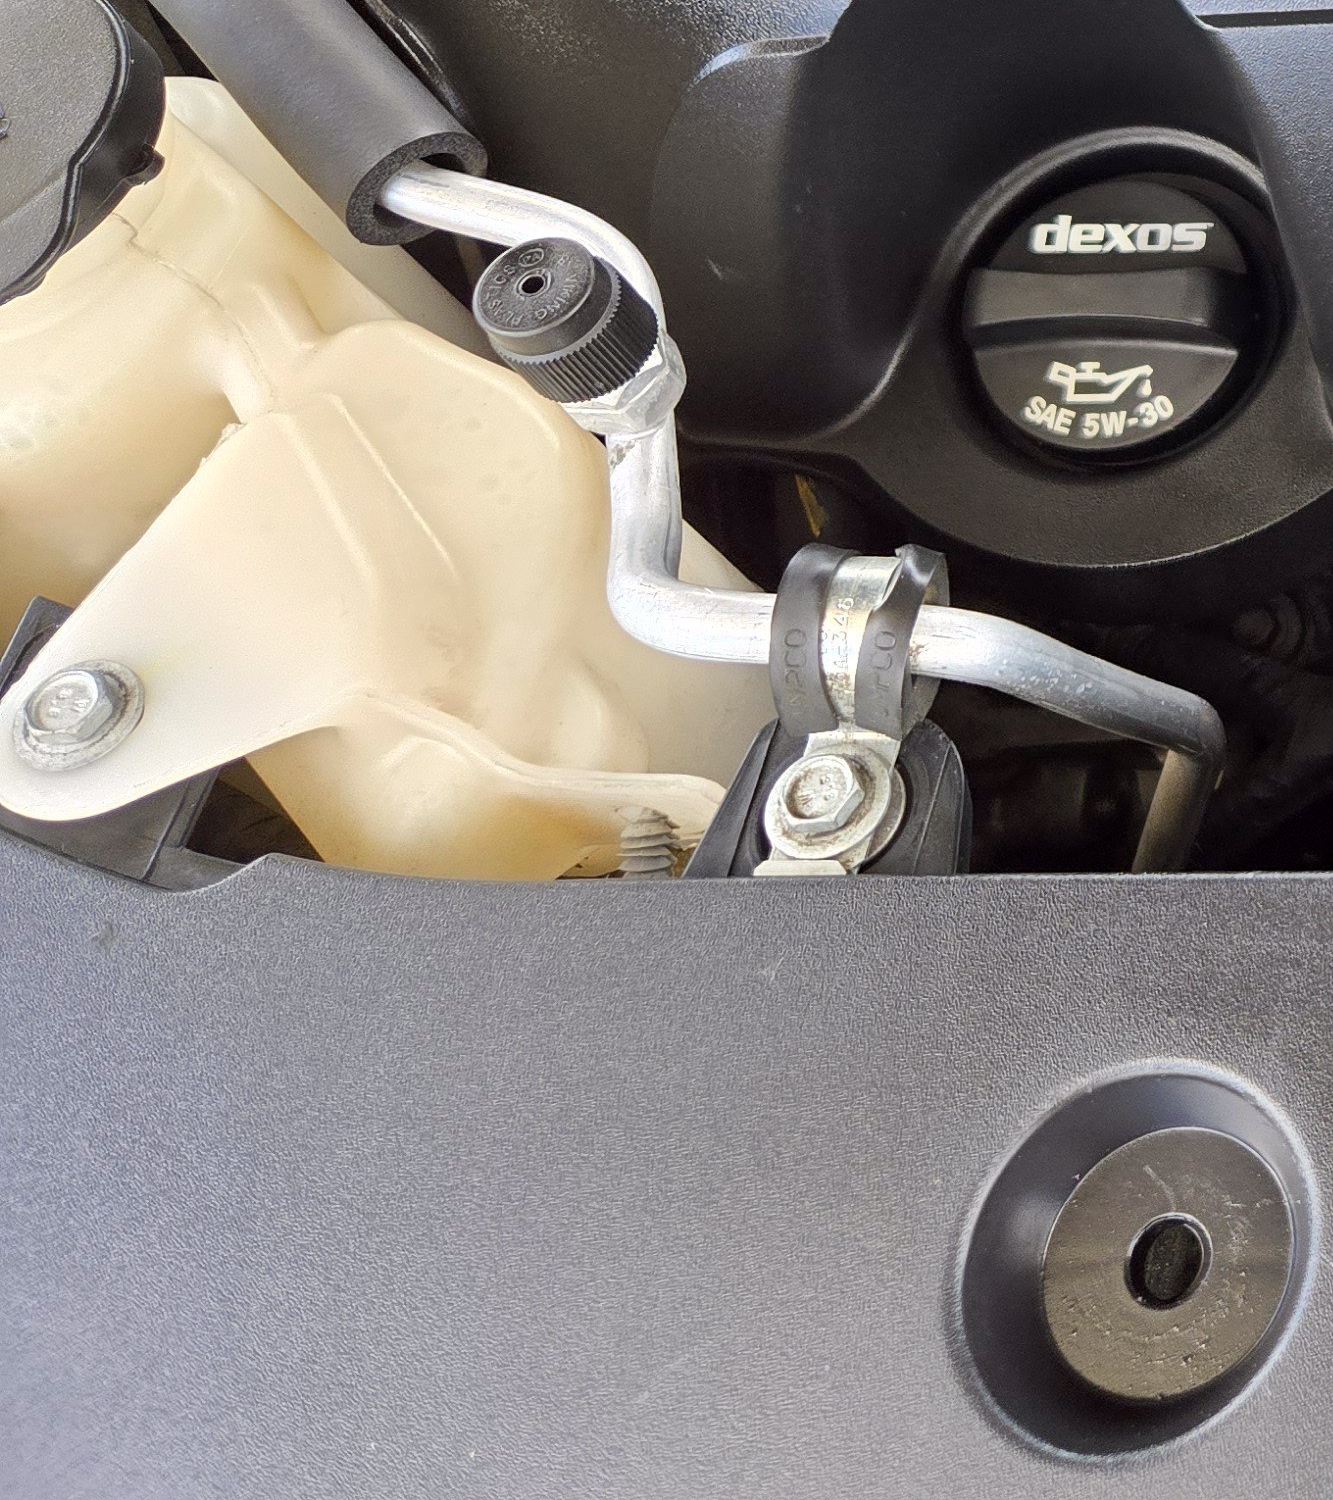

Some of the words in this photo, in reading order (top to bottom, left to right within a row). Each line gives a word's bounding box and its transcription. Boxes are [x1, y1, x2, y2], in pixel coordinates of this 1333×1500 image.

[1031, 214, 1214, 254] dexos
[1023, 396, 1076, 436] SAE
[1081, 395, 1174, 438] 5W-30
